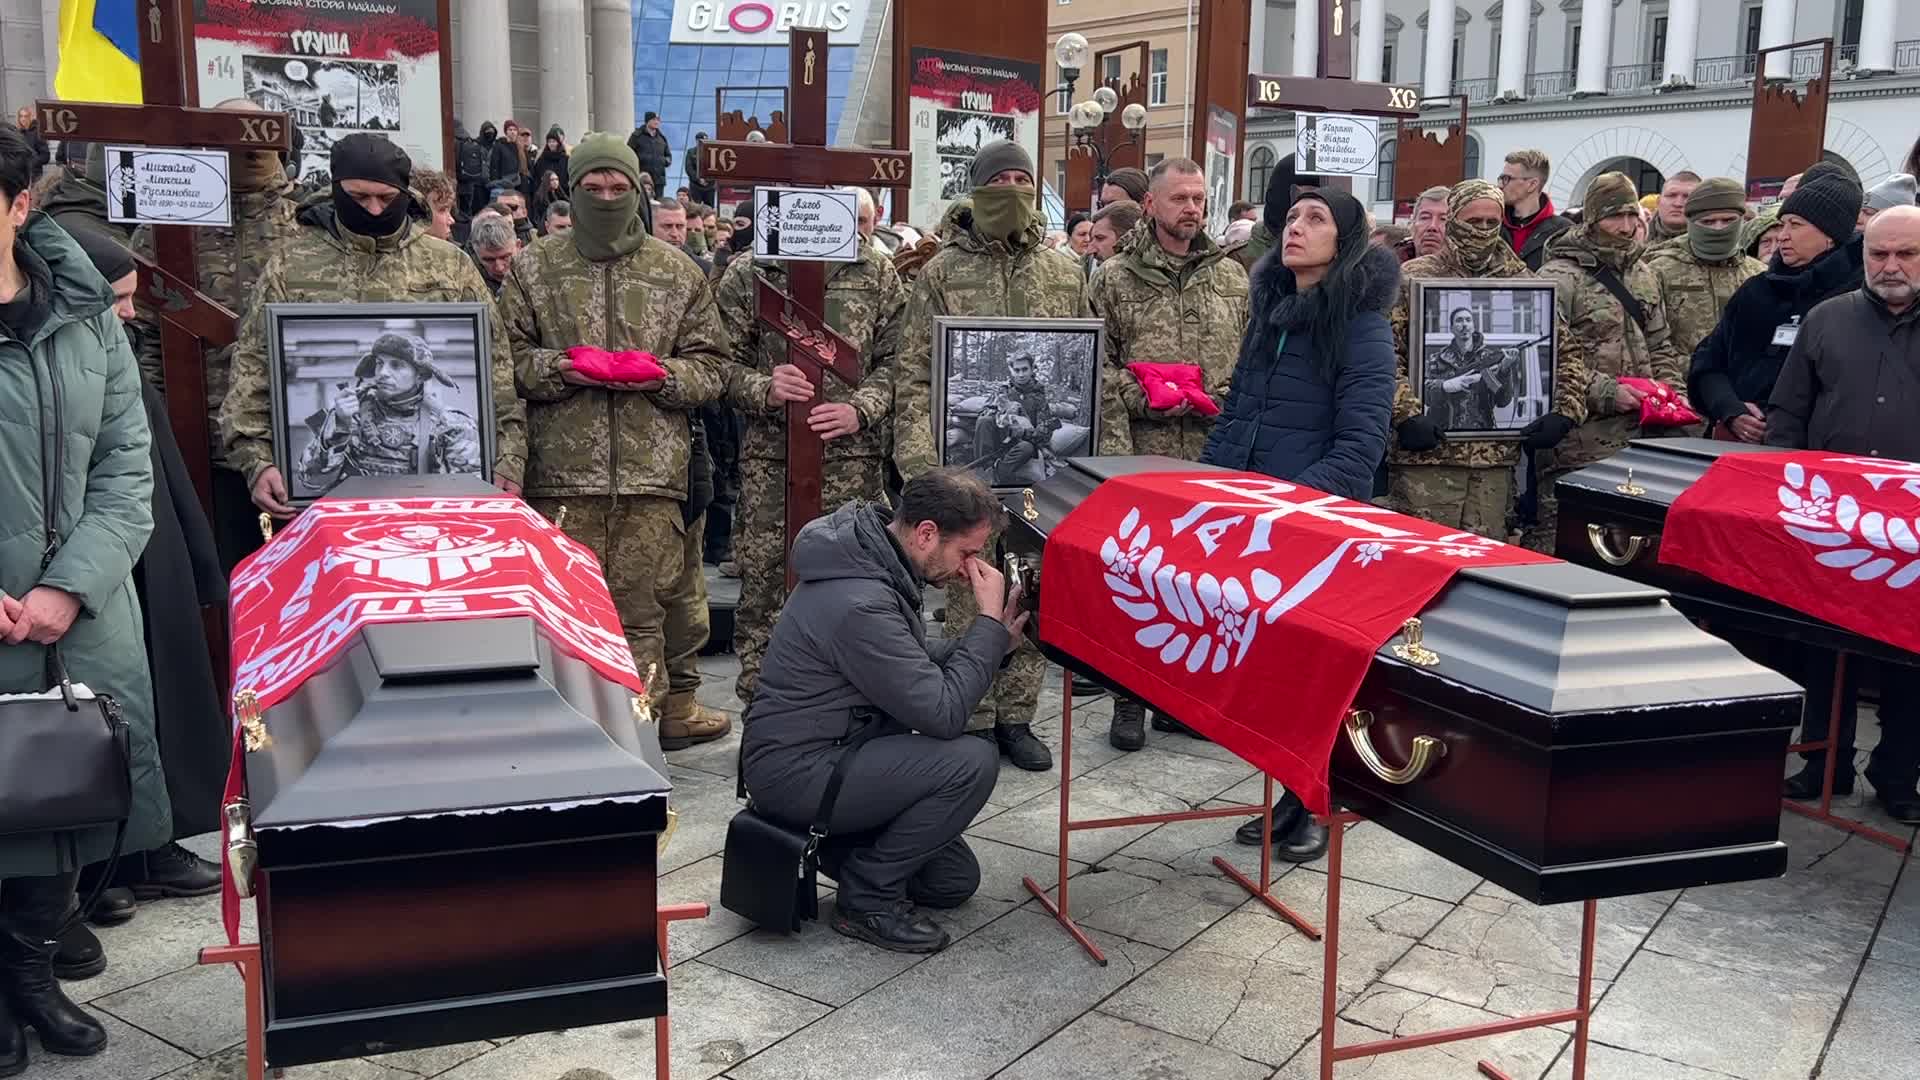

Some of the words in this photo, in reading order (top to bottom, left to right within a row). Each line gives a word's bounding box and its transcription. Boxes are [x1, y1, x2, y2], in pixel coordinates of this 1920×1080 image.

[688, 1, 851, 33] GLOBUS
[291, 30, 350, 55] ГРУША
[207, 55, 235, 79] #14
[960, 91, 992, 112] ГРУША
[786, 209, 821, 223] Богдан
